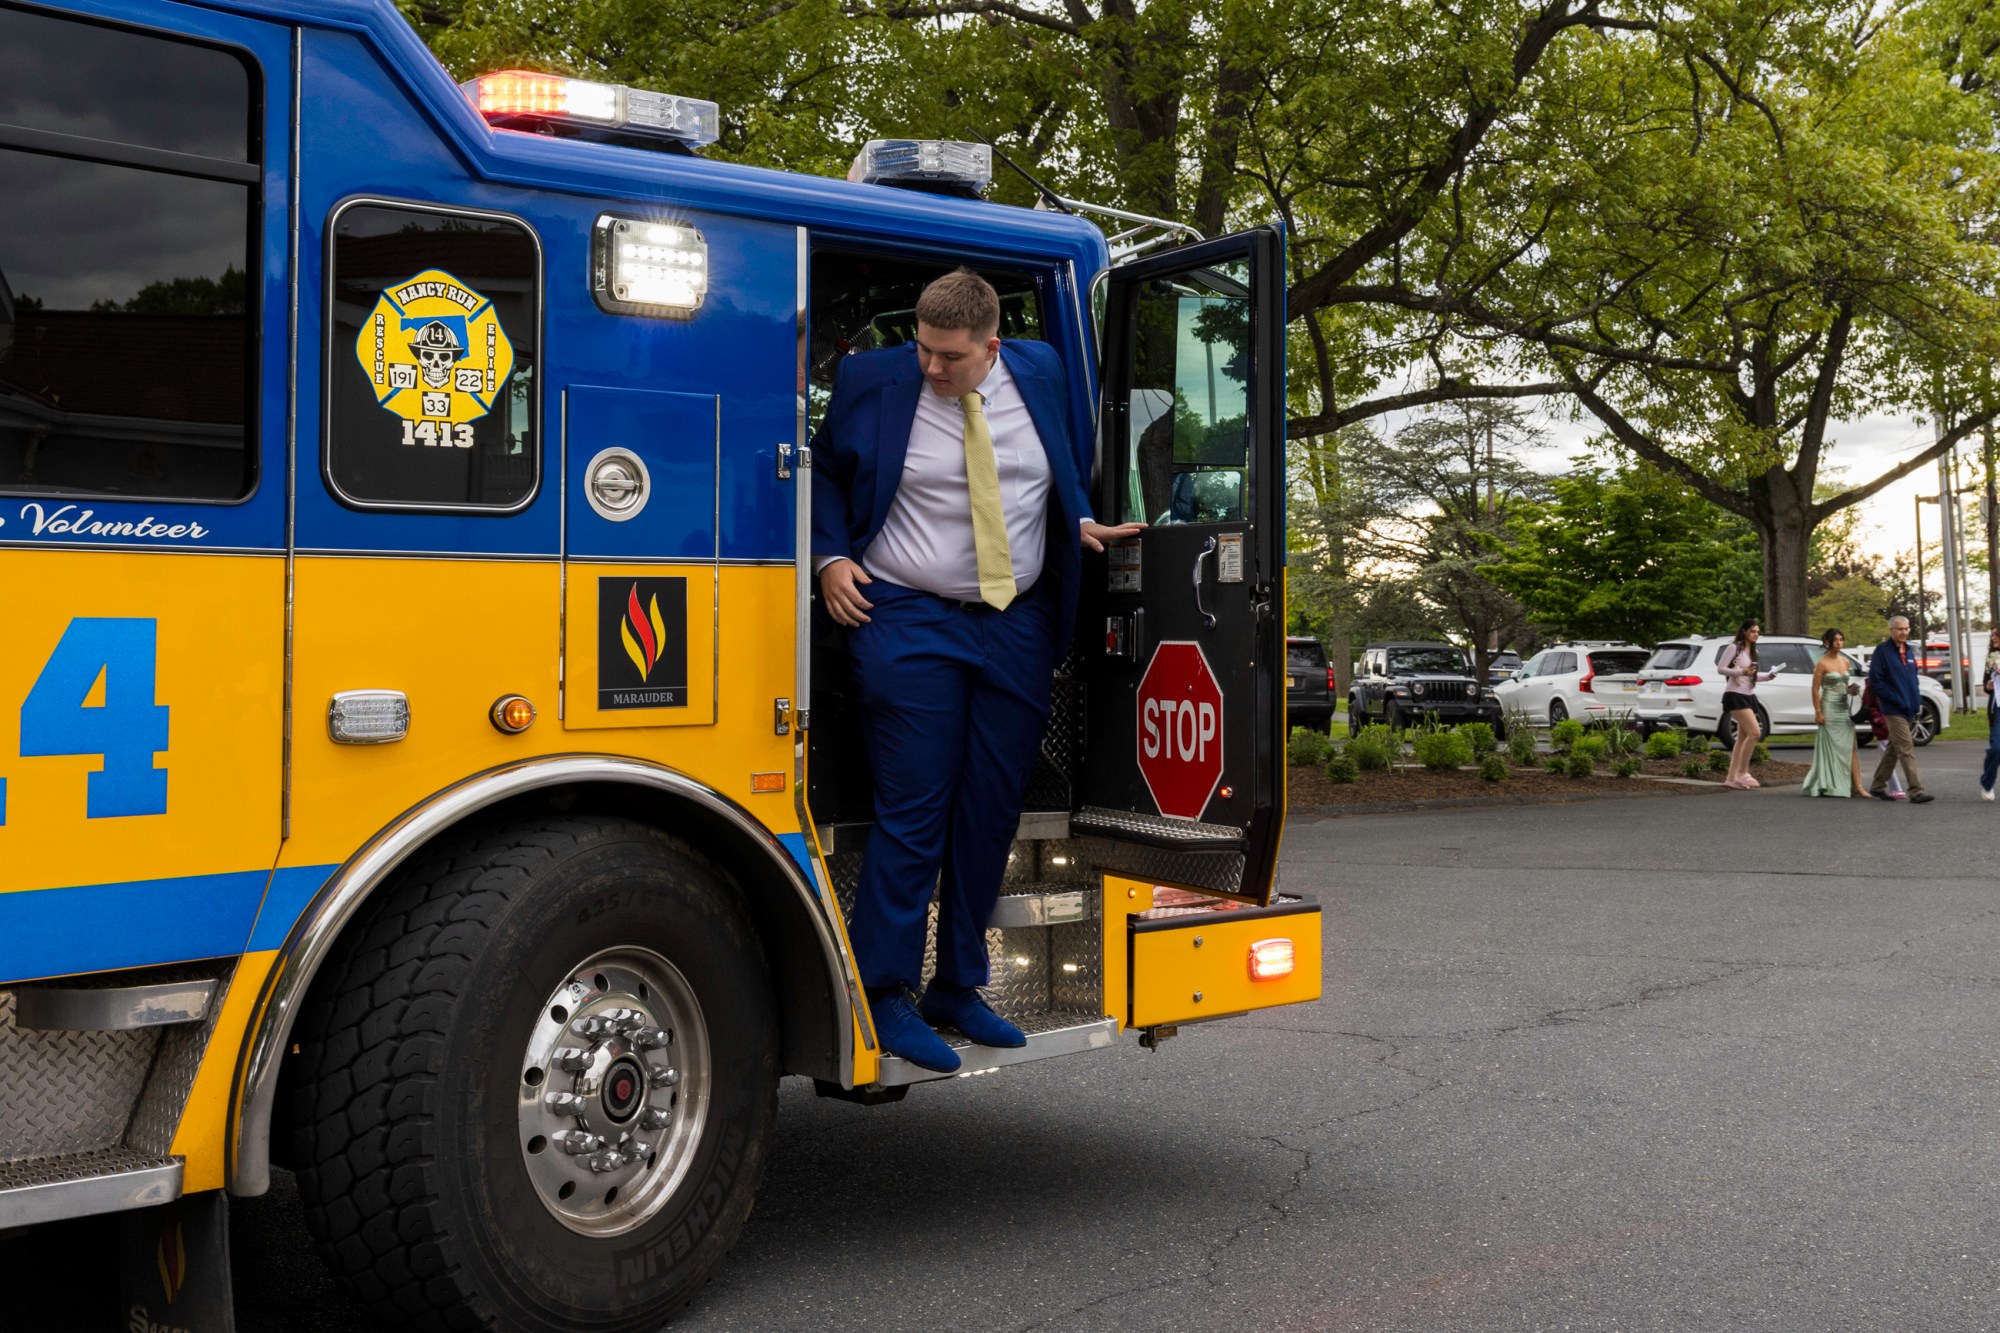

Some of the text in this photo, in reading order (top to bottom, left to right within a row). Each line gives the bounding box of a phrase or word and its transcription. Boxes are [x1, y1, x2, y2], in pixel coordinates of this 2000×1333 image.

[396, 282, 478, 312] NANCY RUN
[375, 313, 385, 384] RESCUE
[430, 327, 444, 341] 14
[487, 324, 496, 391] ENGINE
[393, 371, 412, 385] 191
[459, 374, 479, 388] 22
[426, 399, 446, 413] 33
[402, 420, 474, 448] 1413
[21, 503, 209, 539] Volunteer
[613, 692, 674, 704] MARAUDER
[0, 617, 170, 826] 4
[1143, 698, 1216, 762] STOP
[618, 1119, 746, 1288] MICHELIN
